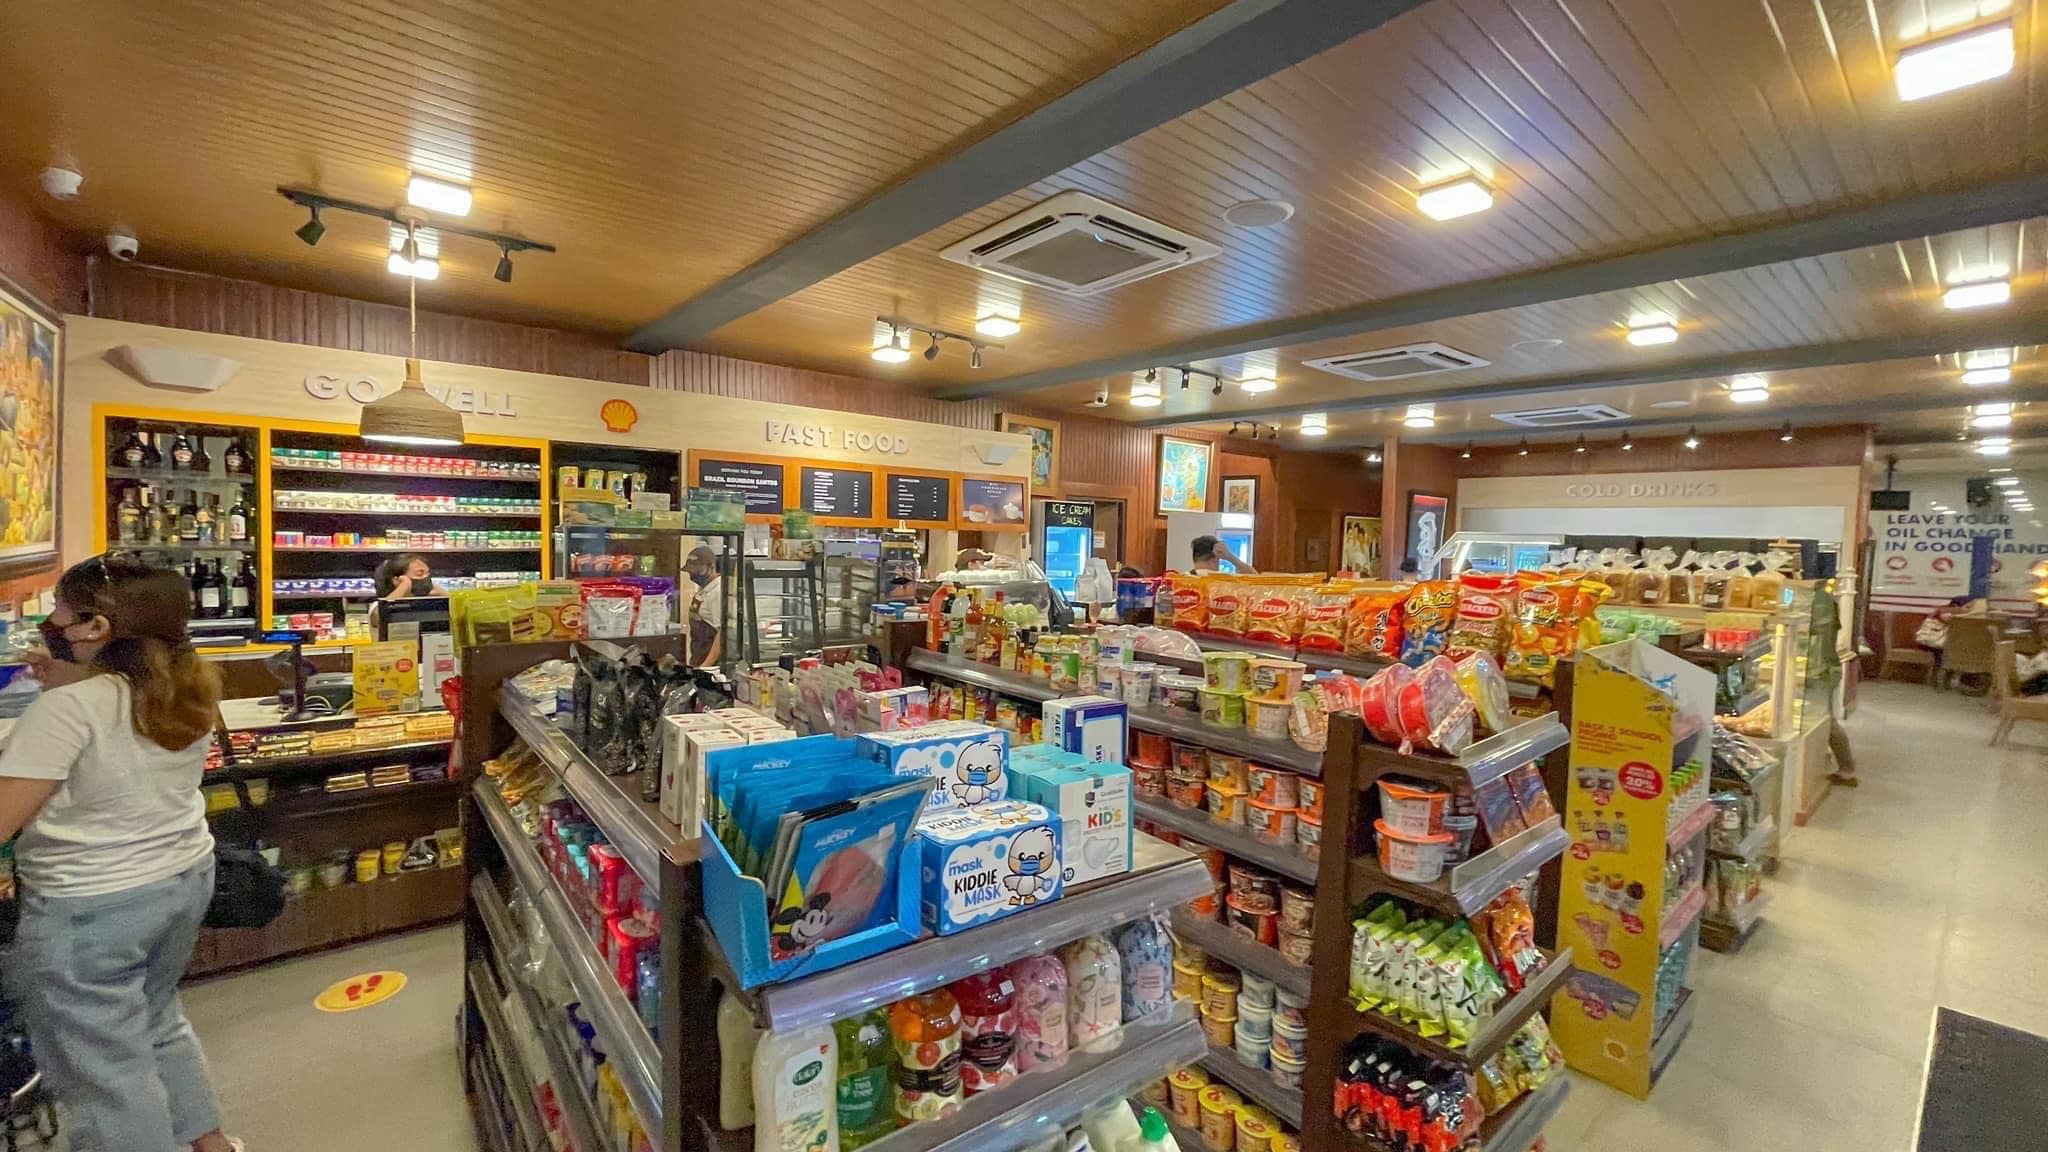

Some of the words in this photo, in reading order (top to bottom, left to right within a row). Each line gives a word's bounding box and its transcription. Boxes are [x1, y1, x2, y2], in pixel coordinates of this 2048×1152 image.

[303, 375, 383, 404] GO
[765, 421, 832, 448] FAST
[842, 430, 910, 455] FOOD
[1566, 483, 1622, 497] COLD
[1630, 481, 1719, 497] DRINKS
[1887, 514, 1945, 525] LEAVE
[1955, 514, 2011, 526] YOUR
[1887, 527, 1919, 539] OIL
[1926, 528, 2014, 540] CHANGE
[1885, 541, 1907, 552] IN
[948, 857, 983, 877] mask
[954, 868, 998, 894] KIDDIE
[964, 885, 1002, 908] MASK
